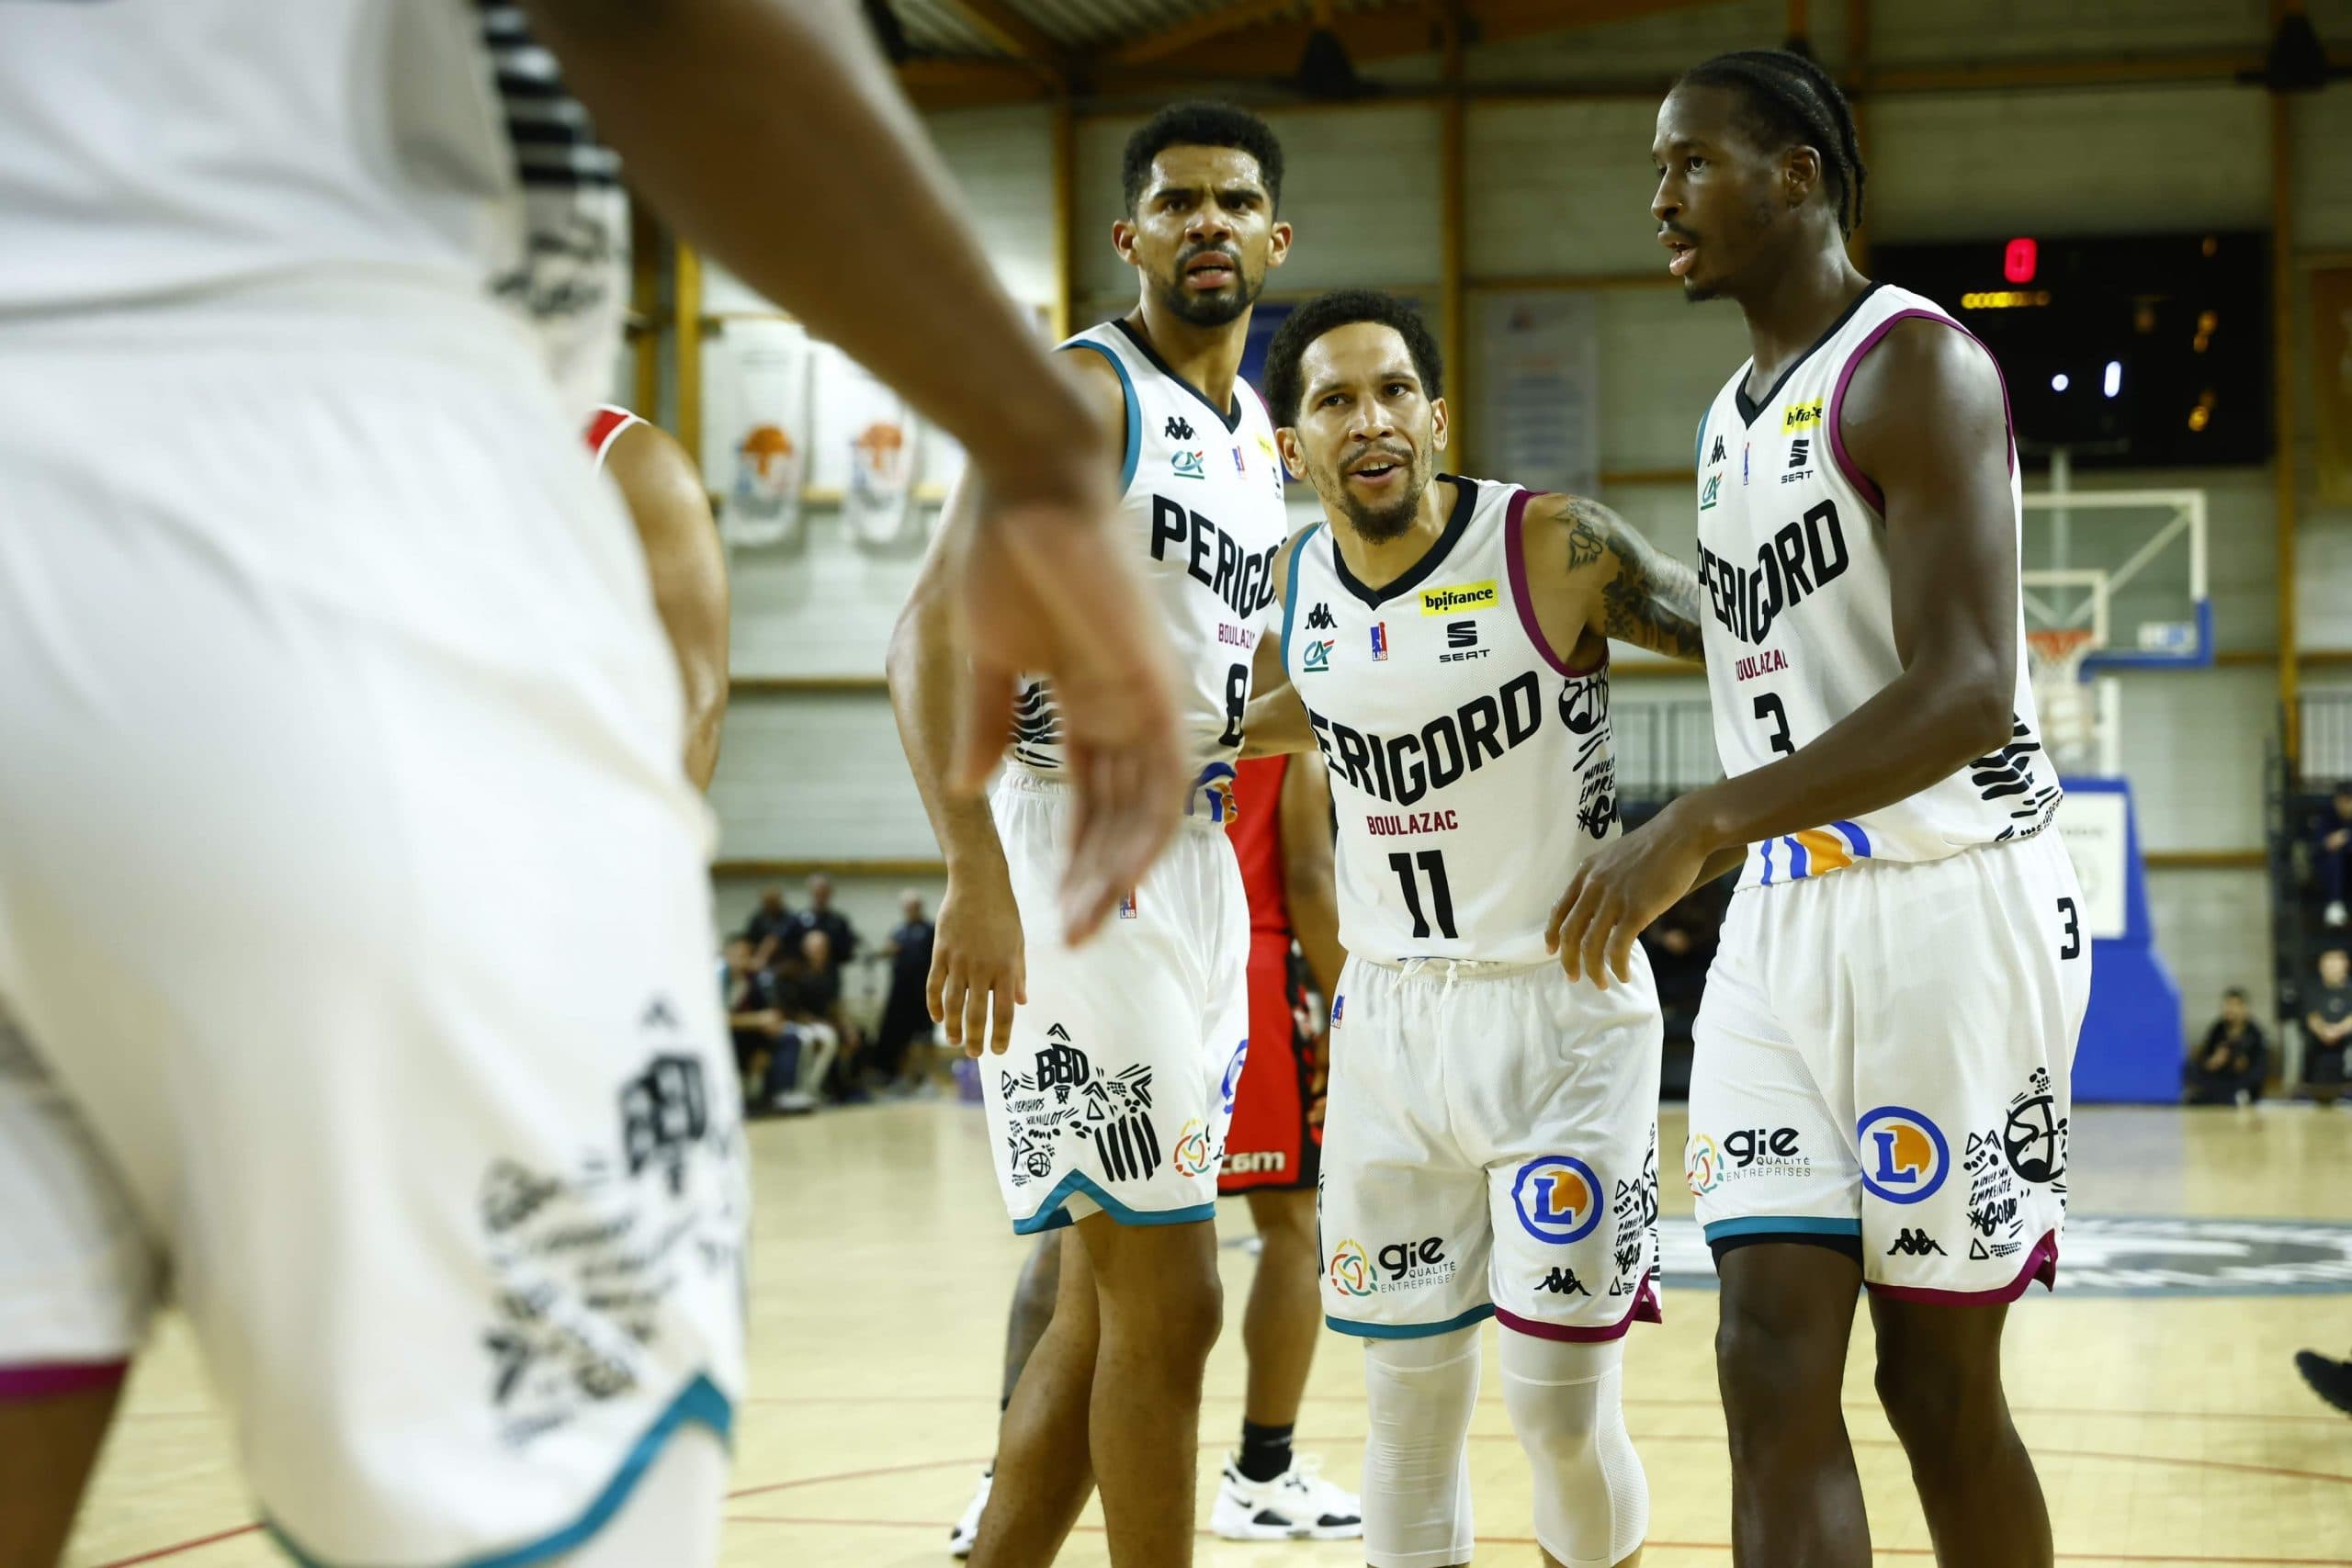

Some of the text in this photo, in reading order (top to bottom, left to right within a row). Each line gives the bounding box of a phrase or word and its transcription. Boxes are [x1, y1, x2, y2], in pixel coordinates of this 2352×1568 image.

[1781, 470, 1815, 484] SEAT
[1151, 493, 1287, 620] PERIGO
[1425, 588, 1494, 611] bpifrance
[1439, 649, 1490, 663] SEAT
[1736, 649, 1789, 682] OULAZA
[1218, 662, 1249, 748] 8
[1302, 671, 1542, 807] ERIGORD
[1366, 810, 1458, 836] BOULAZAC
[1388, 849, 1459, 939] 11
[2057, 897, 2080, 960] 3
[1035, 1043, 1090, 1092] BBD
[1724, 1127, 1800, 1168] gie
[1756, 1156, 1811, 1166] QUALITÉ
[1726, 1167, 1811, 1182] ENTREPRISES
[1378, 1236, 1445, 1281] gie
[1409, 1261, 1456, 1279] QUALITÉ
